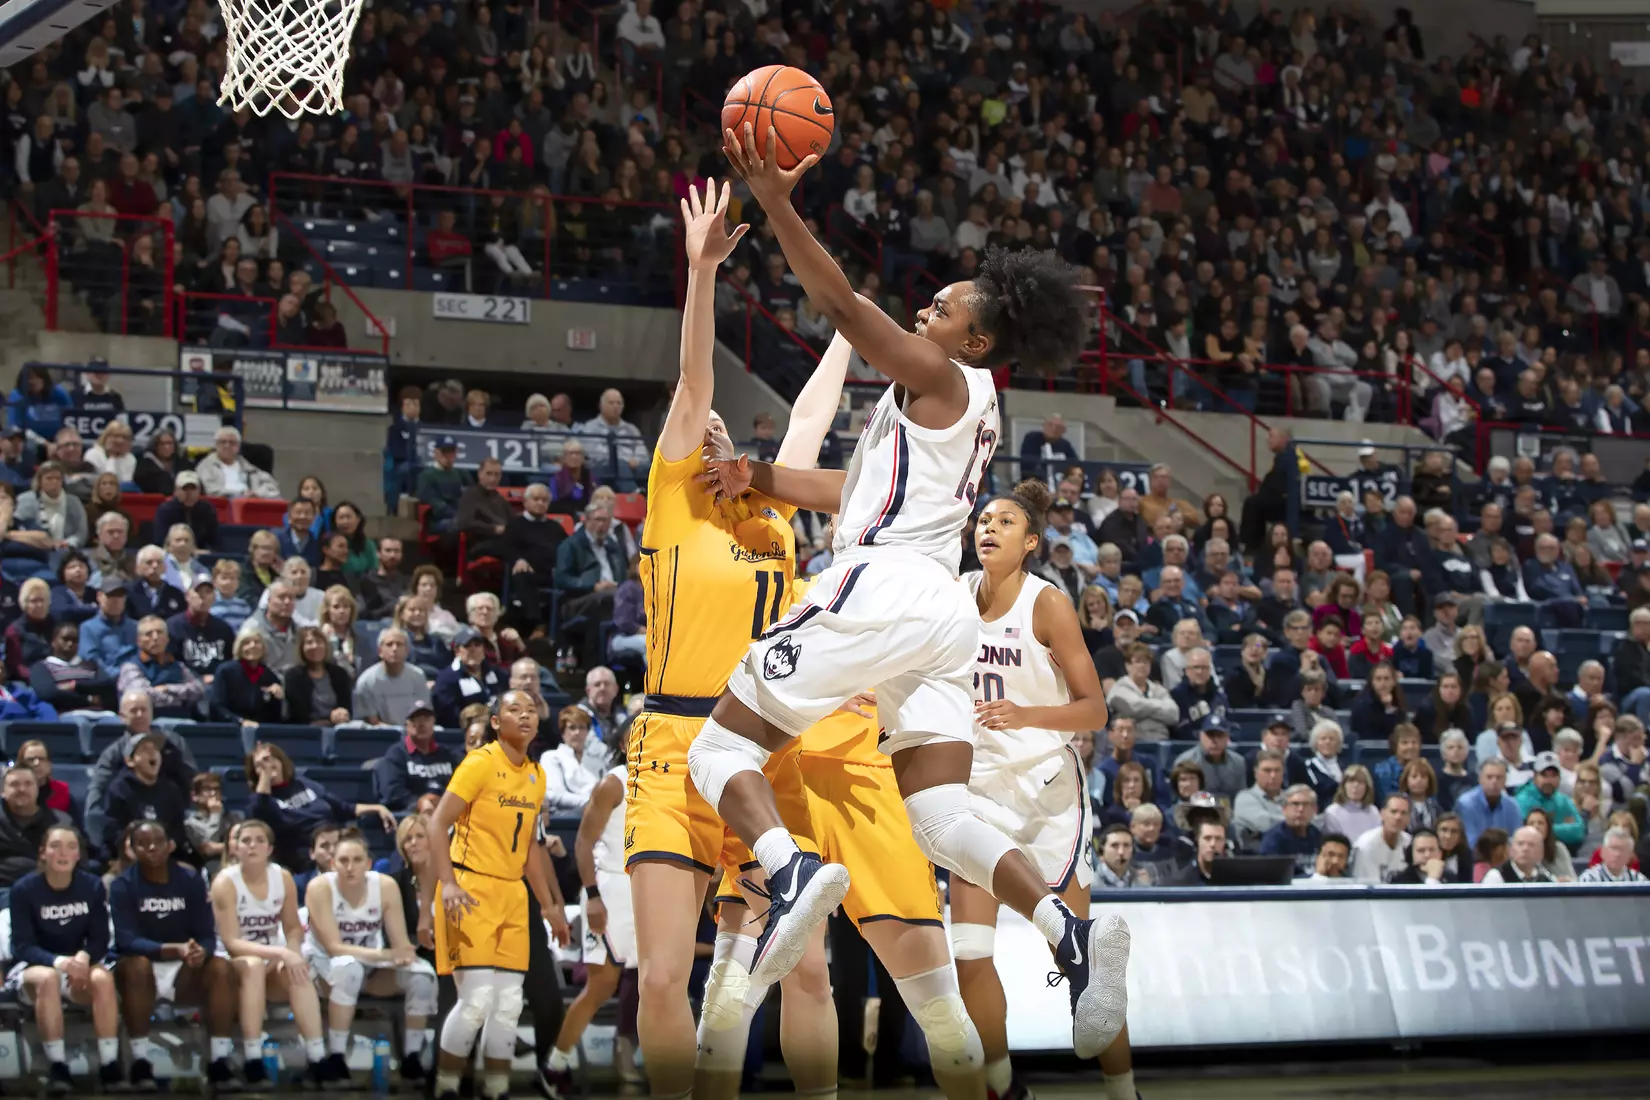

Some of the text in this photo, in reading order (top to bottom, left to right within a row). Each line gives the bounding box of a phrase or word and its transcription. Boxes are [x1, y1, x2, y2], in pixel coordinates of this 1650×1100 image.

[436, 297, 528, 321] SEC 221
[64, 412, 183, 446] SEC 20
[427, 438, 540, 470] SC 121
[954, 419, 997, 507] 13
[1119, 470, 1152, 496] 21
[1308, 481, 1339, 498] SEC
[751, 569, 784, 640] 11
[511, 812, 524, 853] 1
[40, 901, 89, 920] UCONN
